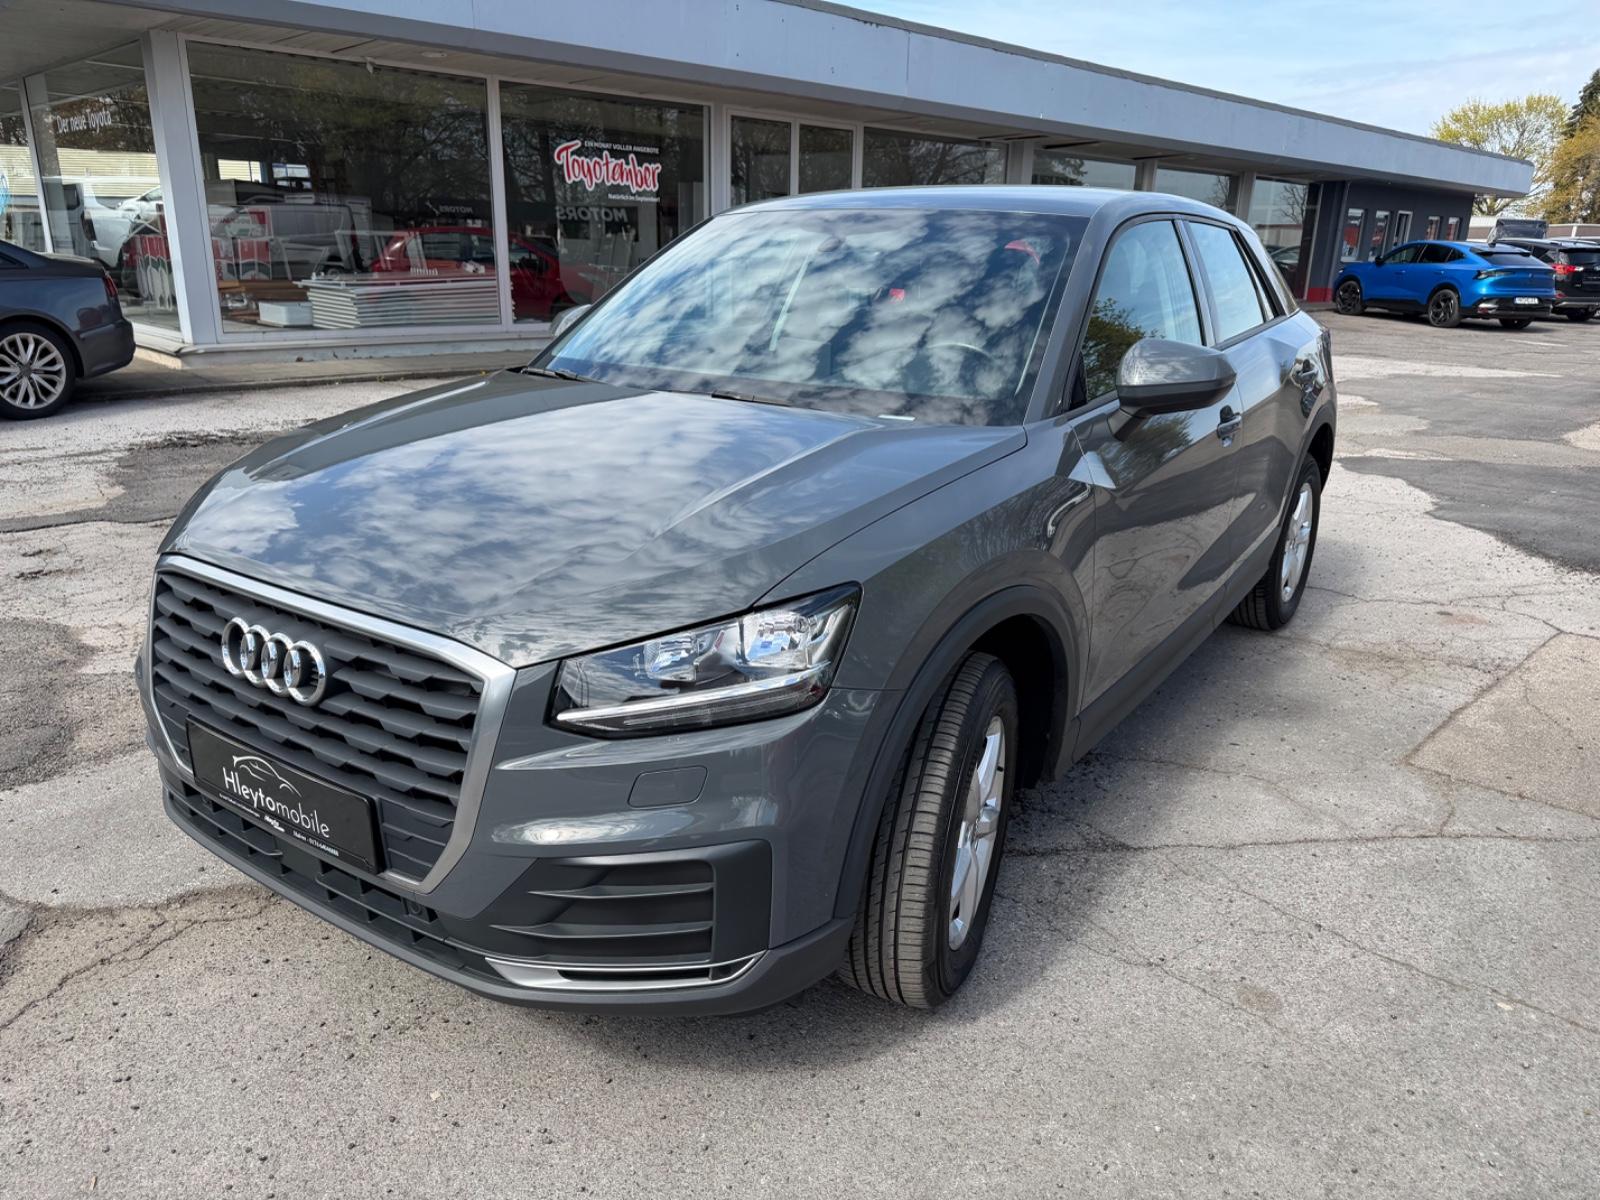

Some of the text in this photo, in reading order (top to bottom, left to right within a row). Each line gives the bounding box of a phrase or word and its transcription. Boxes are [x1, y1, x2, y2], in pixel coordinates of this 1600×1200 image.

[57, 107, 112, 134] Der neue Toyota
[554, 140, 661, 193] Toyotember
[584, 140, 594, 148] EIN
[612, 143, 632, 151] VOLLER
[632, 145, 660, 154] ANGEBOTE
[222, 766, 330, 838] Hleytomobile
